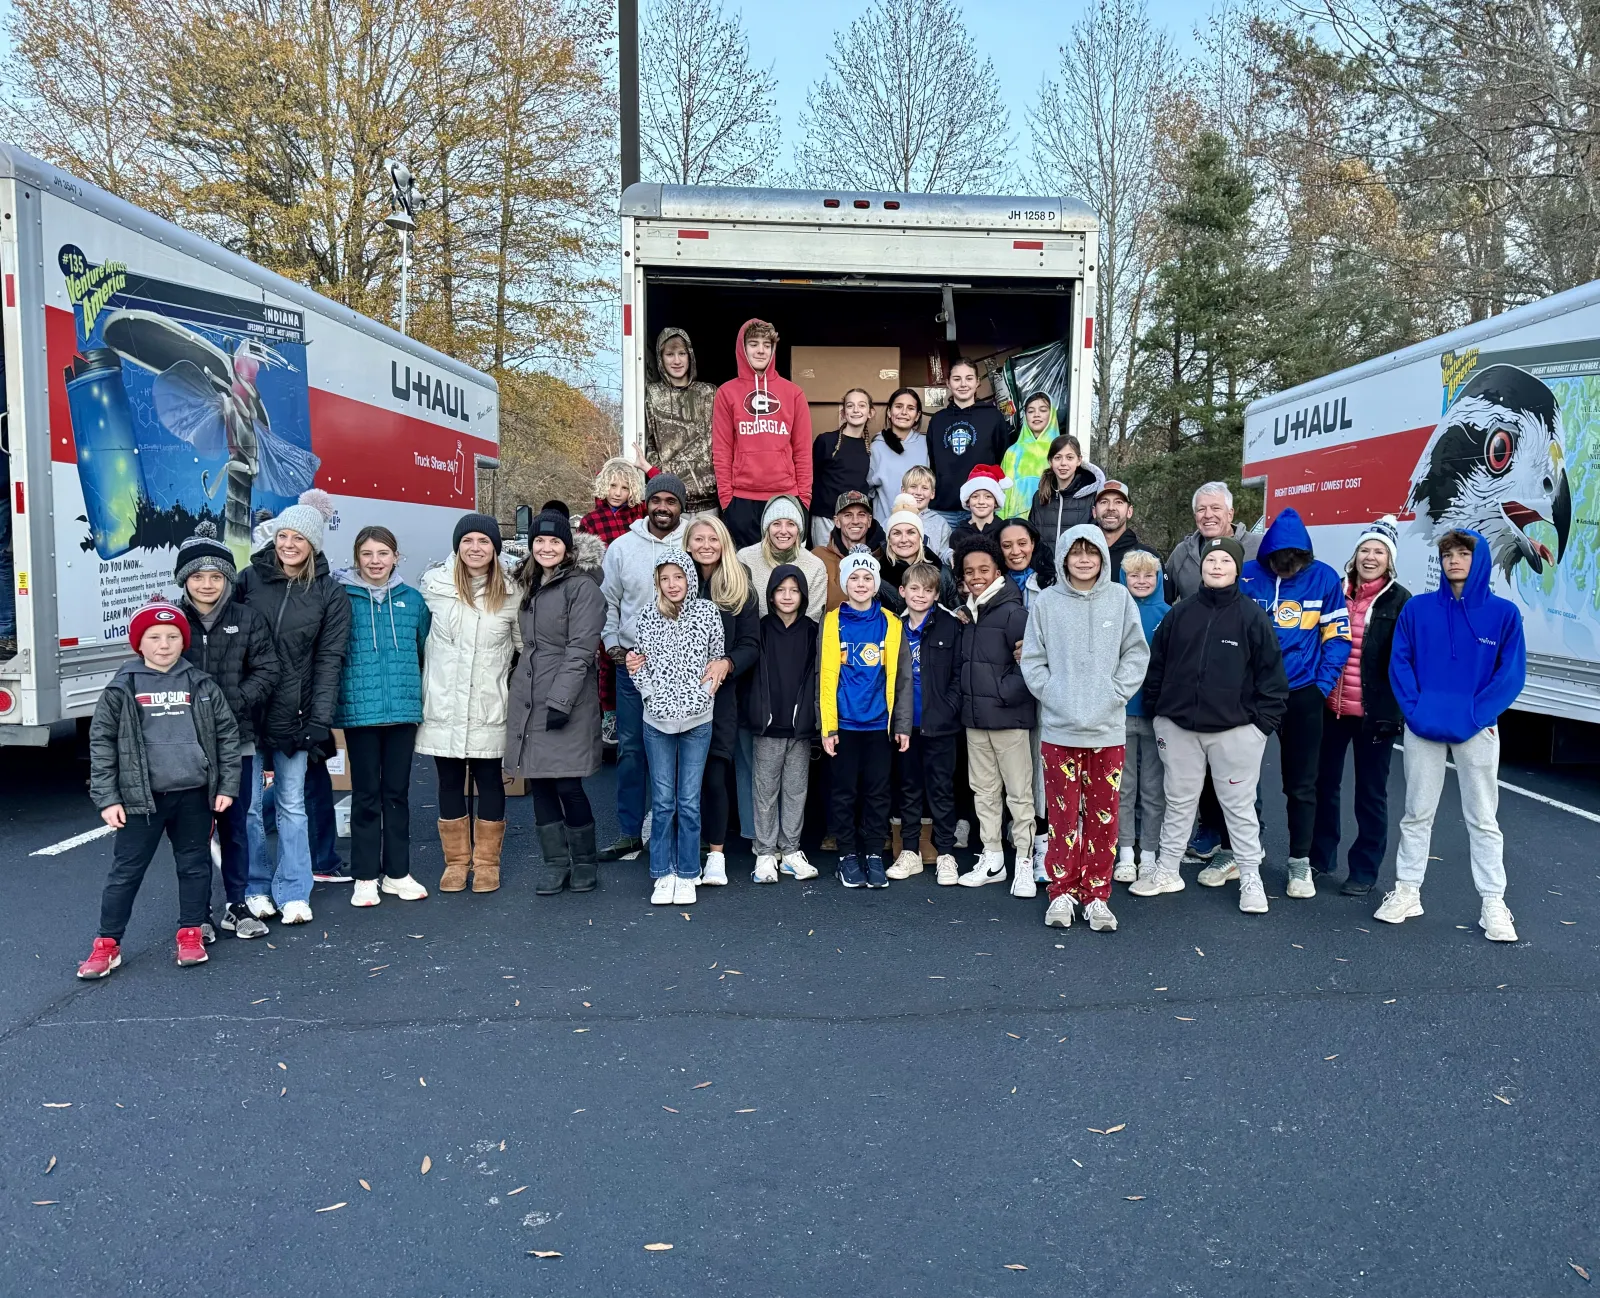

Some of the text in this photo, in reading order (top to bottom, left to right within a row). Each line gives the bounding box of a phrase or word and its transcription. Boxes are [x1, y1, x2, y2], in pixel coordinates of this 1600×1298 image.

[1007, 210, 1056, 221] JH 1258 D
[62, 253, 84, 275] #135
[65, 264, 105, 305] Venture
[82, 272, 127, 342] America
[264, 307, 300, 328] INDIANA
[738, 419, 789, 435] GEORGIA
[413, 451, 459, 476] Truck Share 24/7
[1274, 487, 1288, 498] RIGHT
[1287, 482, 1316, 496] EQUIPMENT
[1320, 479, 1344, 491] LOWEST
[1344, 477, 1362, 489] COST
[99, 562, 109, 574] DID
[110, 560, 122, 573] YOU
[100, 577, 105, 587] A
[121, 574, 139, 583] converts
[140, 570, 158, 579] chemical
[159, 570, 172, 578] energy
[101, 588, 114, 597] What
[115, 583, 144, 594] advancements
[145, 581, 156, 590] have
[156, 579, 167, 587] been
[101, 599, 110, 608] the
[111, 597, 127, 605] science
[128, 595, 142, 603] behind
[102, 609, 121, 622] LEARN
[1547, 607, 1577, 620] PACIFIC OCEAN
[1335, 617, 1351, 635] 2
[150, 691, 186, 705] TOP GUN
